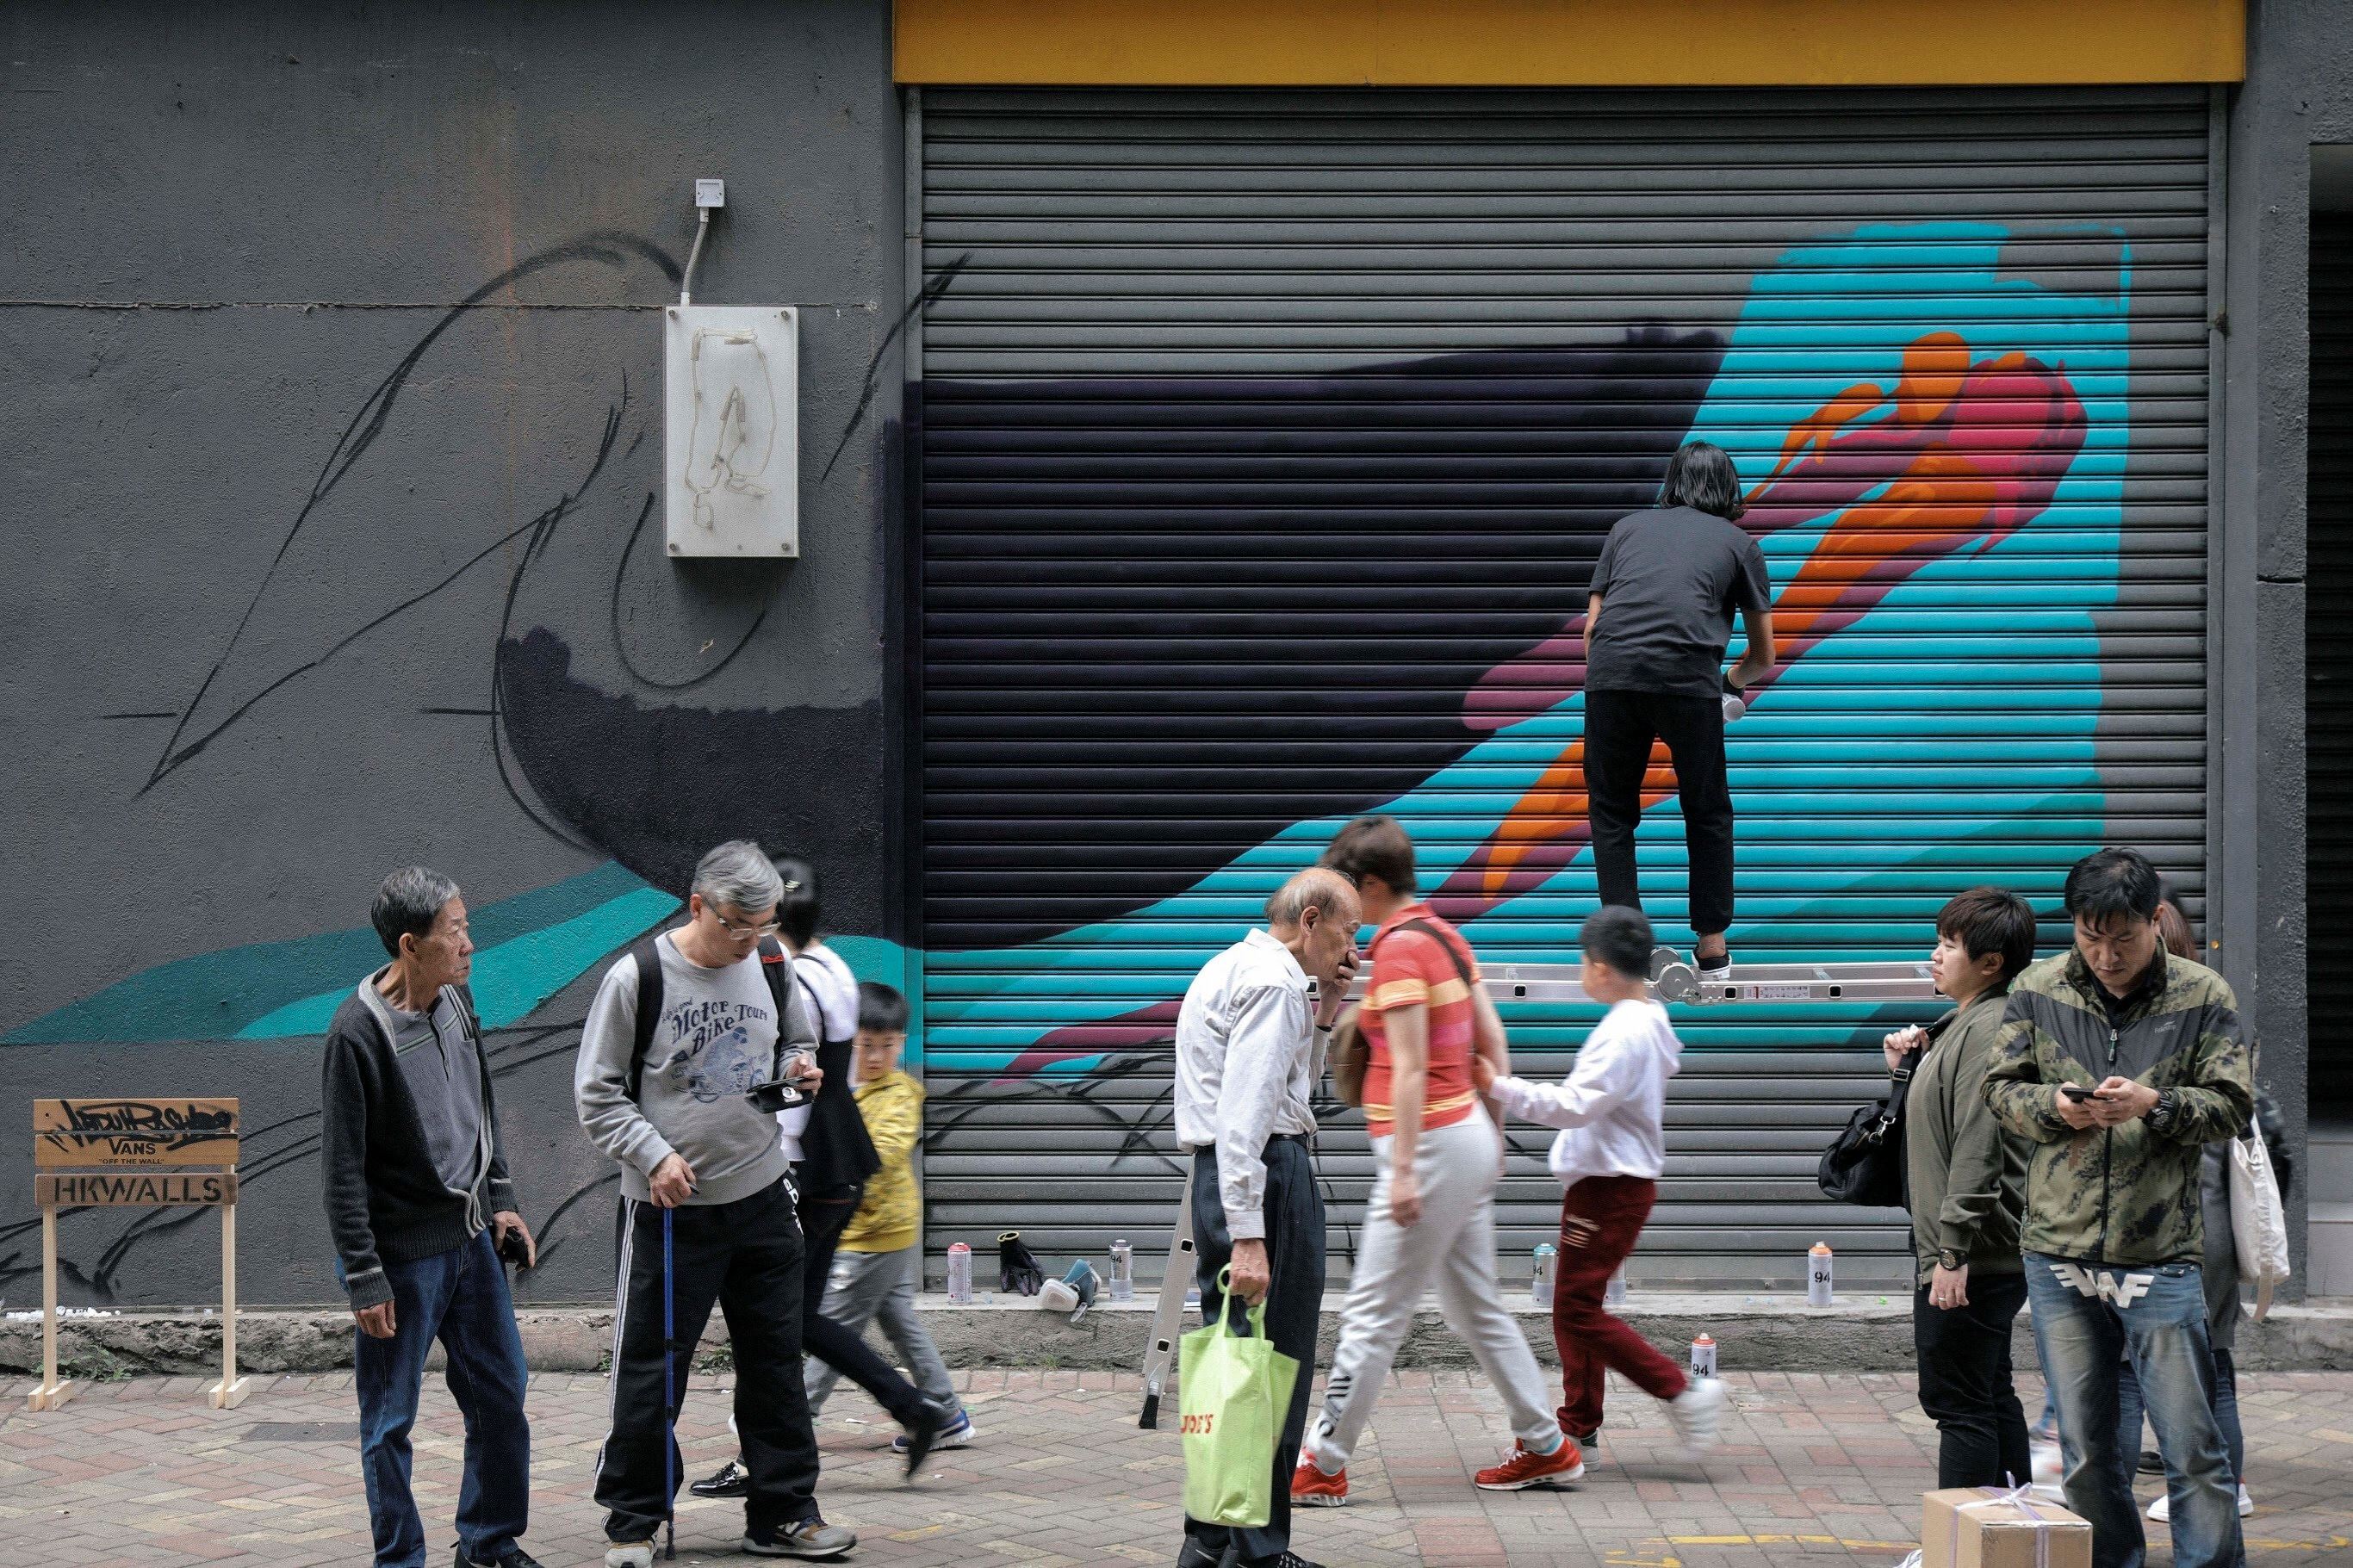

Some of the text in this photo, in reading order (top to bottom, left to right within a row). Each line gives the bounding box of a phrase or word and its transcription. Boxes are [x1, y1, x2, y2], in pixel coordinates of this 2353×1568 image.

[672, 1001, 729, 1044] Motor
[734, 1004, 768, 1021] Tours
[691, 1016, 736, 1057] Bike
[109, 1137, 156, 1155] VANS
[54, 1177, 221, 1203] HKWALLS
[1110, 1254, 1123, 1264] 94
[1814, 1271, 1831, 1283] 94
[1692, 1363, 1710, 1377] 94
